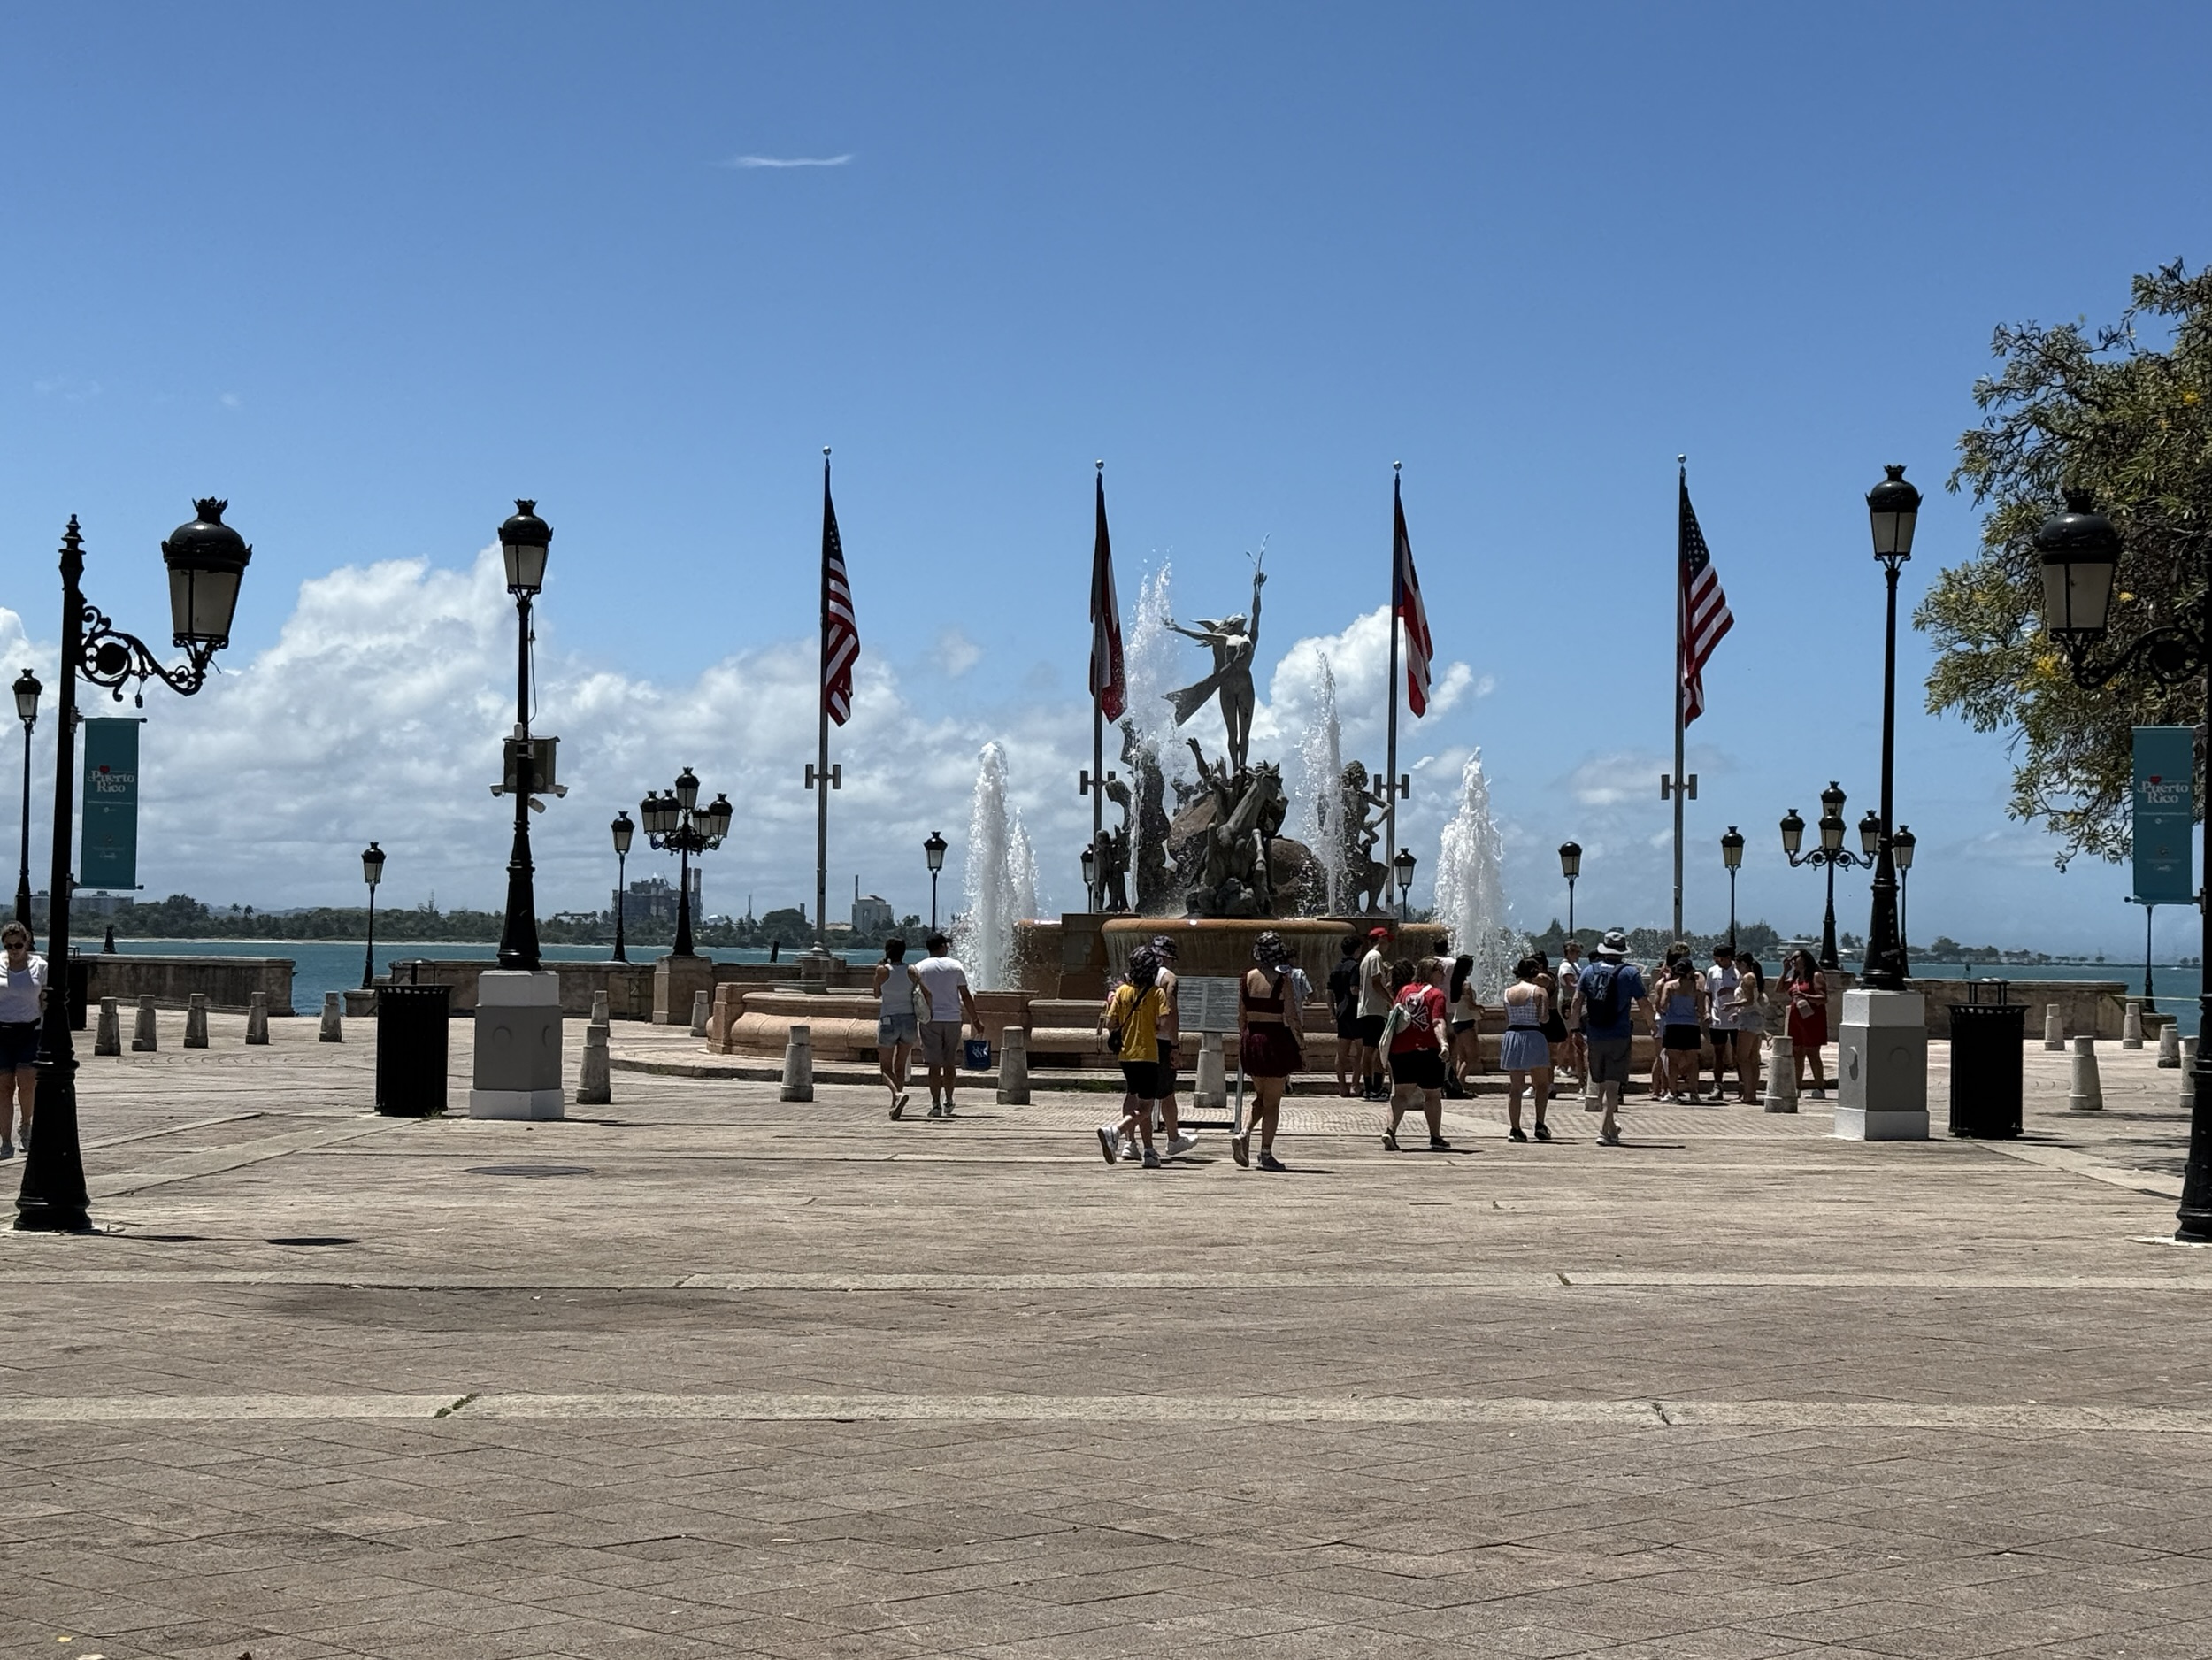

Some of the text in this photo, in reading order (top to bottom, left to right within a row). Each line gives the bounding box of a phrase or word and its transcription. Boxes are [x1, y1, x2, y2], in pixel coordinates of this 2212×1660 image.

[88, 770, 135, 783] Puerto
[96, 781, 127, 793] Rico
[2137, 780, 2189, 793] Puerto
[2147, 792, 2179, 804] Rico
